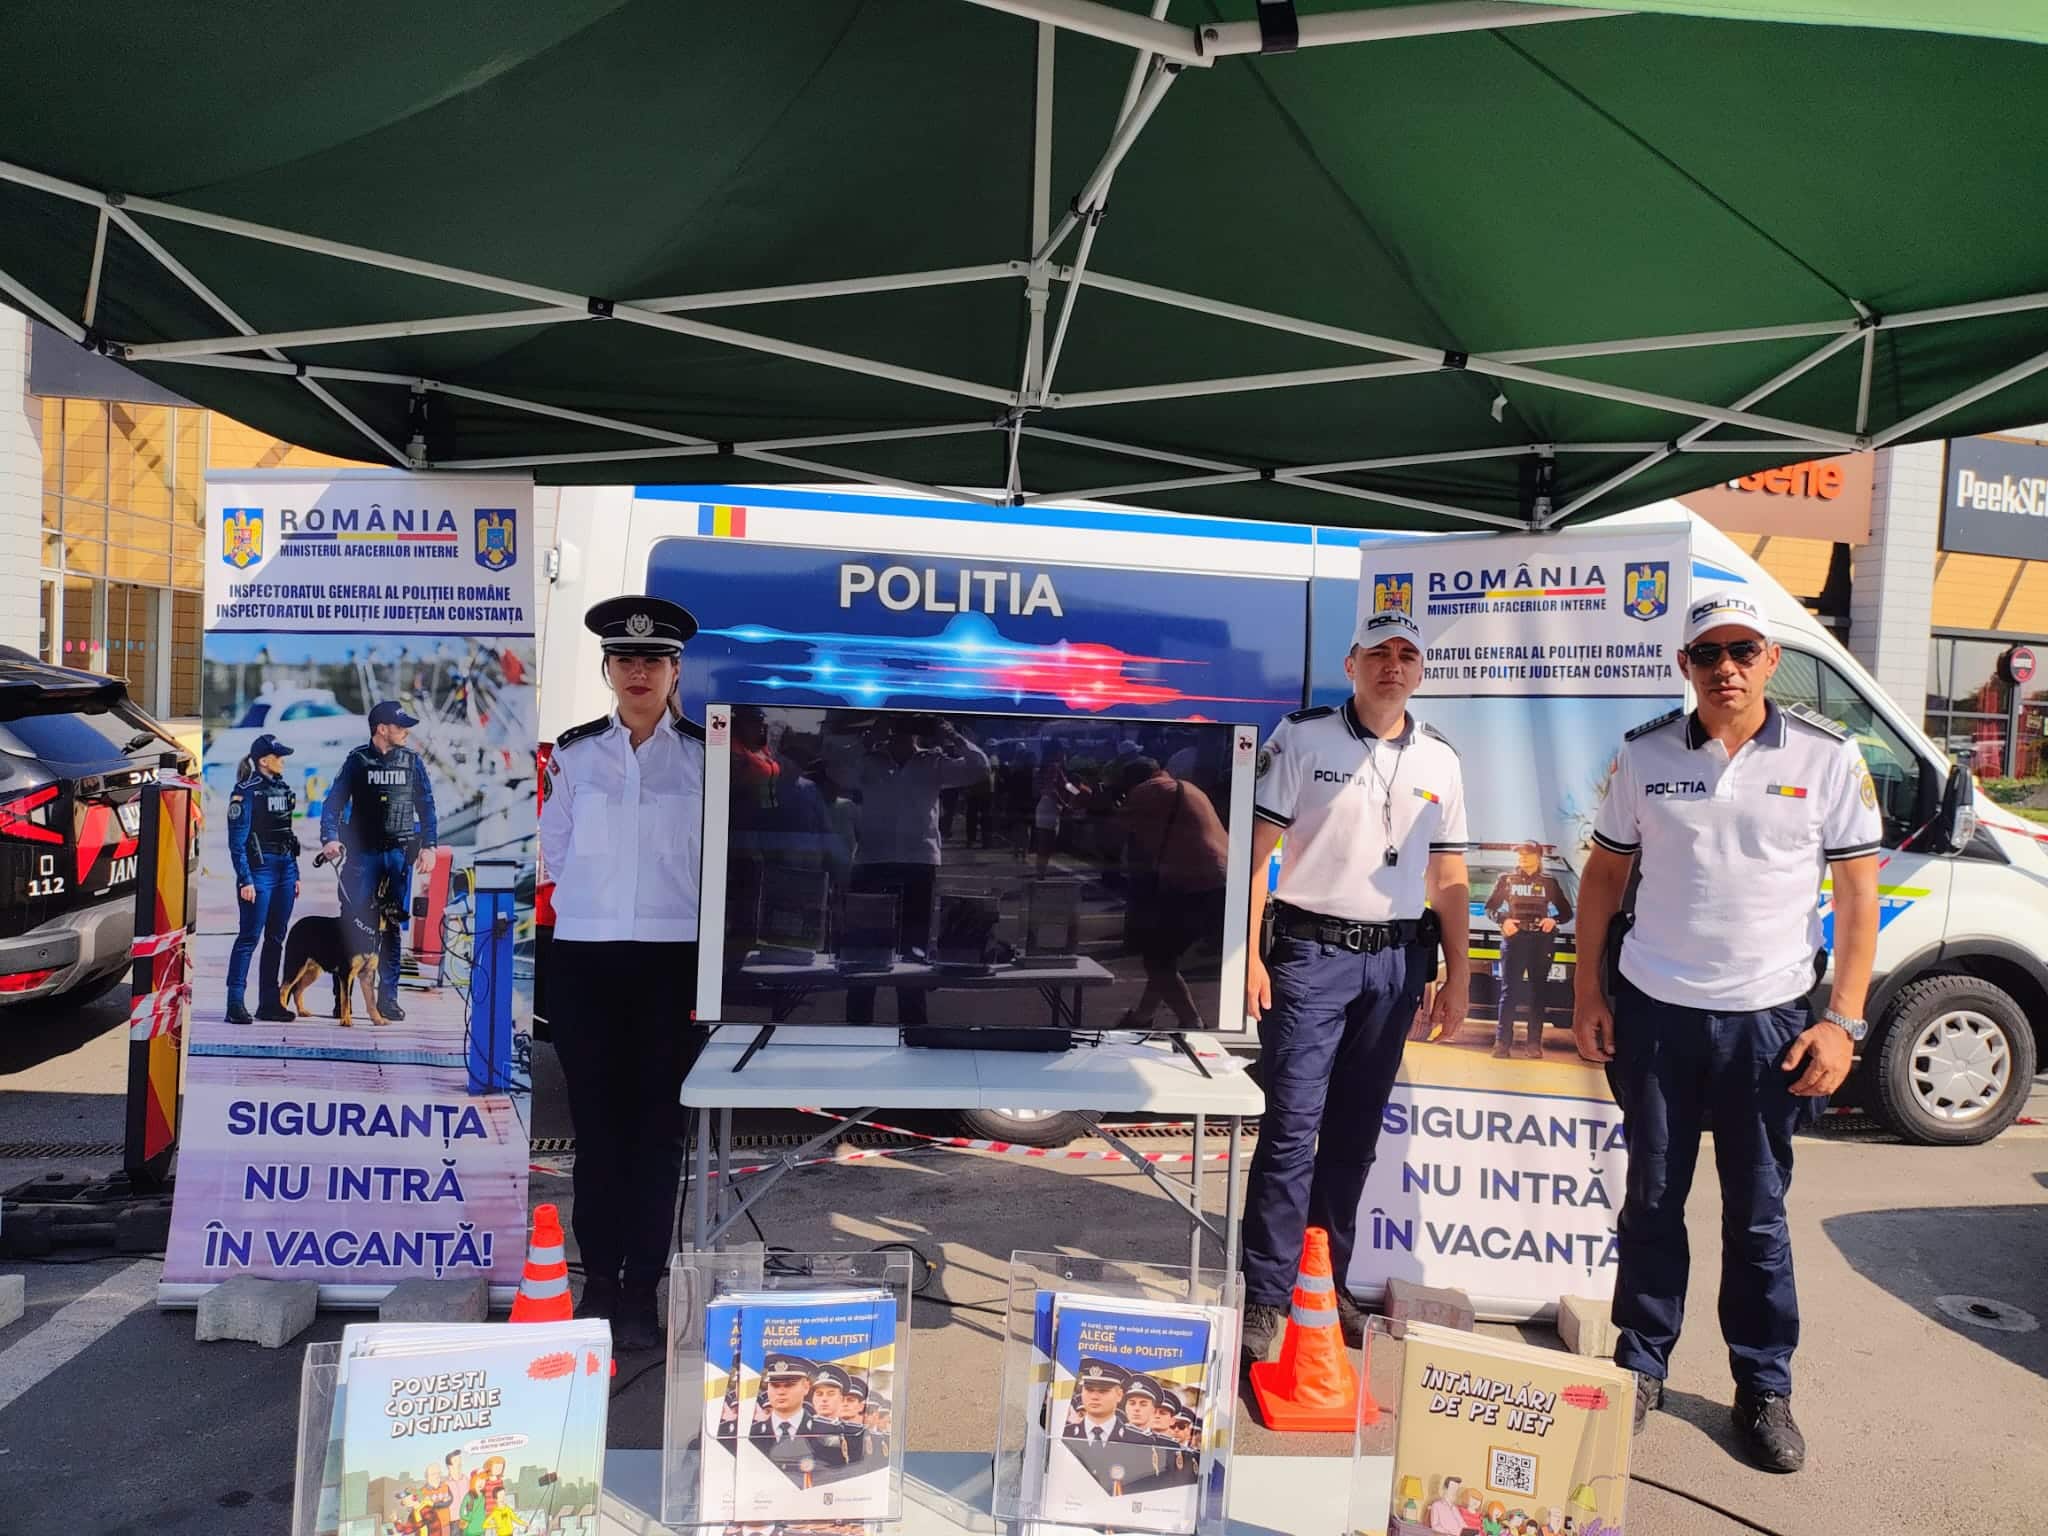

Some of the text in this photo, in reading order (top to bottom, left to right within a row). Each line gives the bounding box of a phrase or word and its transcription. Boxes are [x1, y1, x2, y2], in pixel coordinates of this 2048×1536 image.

[280, 504, 458, 531] ROMÂNIA
[280, 544, 459, 558] MINISTERUL AFACERILOR INTERNE
[1429, 563, 1606, 592] ROMÂNIA
[229, 583, 511, 604] INSPECTORATUL GENERAL AL POLIȚIEI ROMÂNE
[840, 564, 1064, 617] POLITIA
[216, 603, 523, 625] INSPECTORATUL DE POLIȚIE JUDEȚEAN CONSTANȚA
[1428, 598, 1606, 616] MINISTERUL AFACERILOR INTERNE
[1692, 599, 1758, 619] POLITIA
[1367, 615, 1419, 632] POLITIA
[1426, 641, 1663, 663] ORATUL GENERAL AL POLIȚIEI ROMÂNE
[1424, 663, 1672, 682] RATUL DE POLIȚIE JUDEȚEAN CONSTANȚA
[367, 770, 406, 785] POLITIA
[1645, 781, 1707, 797] POLITIA
[108, 855, 139, 886] JAN
[28, 877, 65, 897] 112
[228, 1101, 488, 1149] SIGURANȚA
[1382, 1103, 1628, 1161] SIGURANȚA
[245, 1158, 465, 1202] NU INTRĂ
[1402, 1161, 1612, 1210] NU INTRĂ
[1370, 1207, 1413, 1252] ÎN
[204, 1221, 493, 1278] ÎN VACANȚĂ!
[764, 1325, 800, 1336] ALEGE
[1080, 1330, 1116, 1342] ALEGE
[762, 1337, 802, 1348] profesia
[806, 1336, 818, 1346] de
[1078, 1341, 1117, 1353] profesia
[1121, 1344, 1132, 1354] de
[391, 1370, 487, 1397] POVEȘTI
[384, 1388, 501, 1418] COTIDIENE
[391, 1409, 493, 1438] DIGITALE
[1429, 1395, 1554, 1437] DE PE NET
